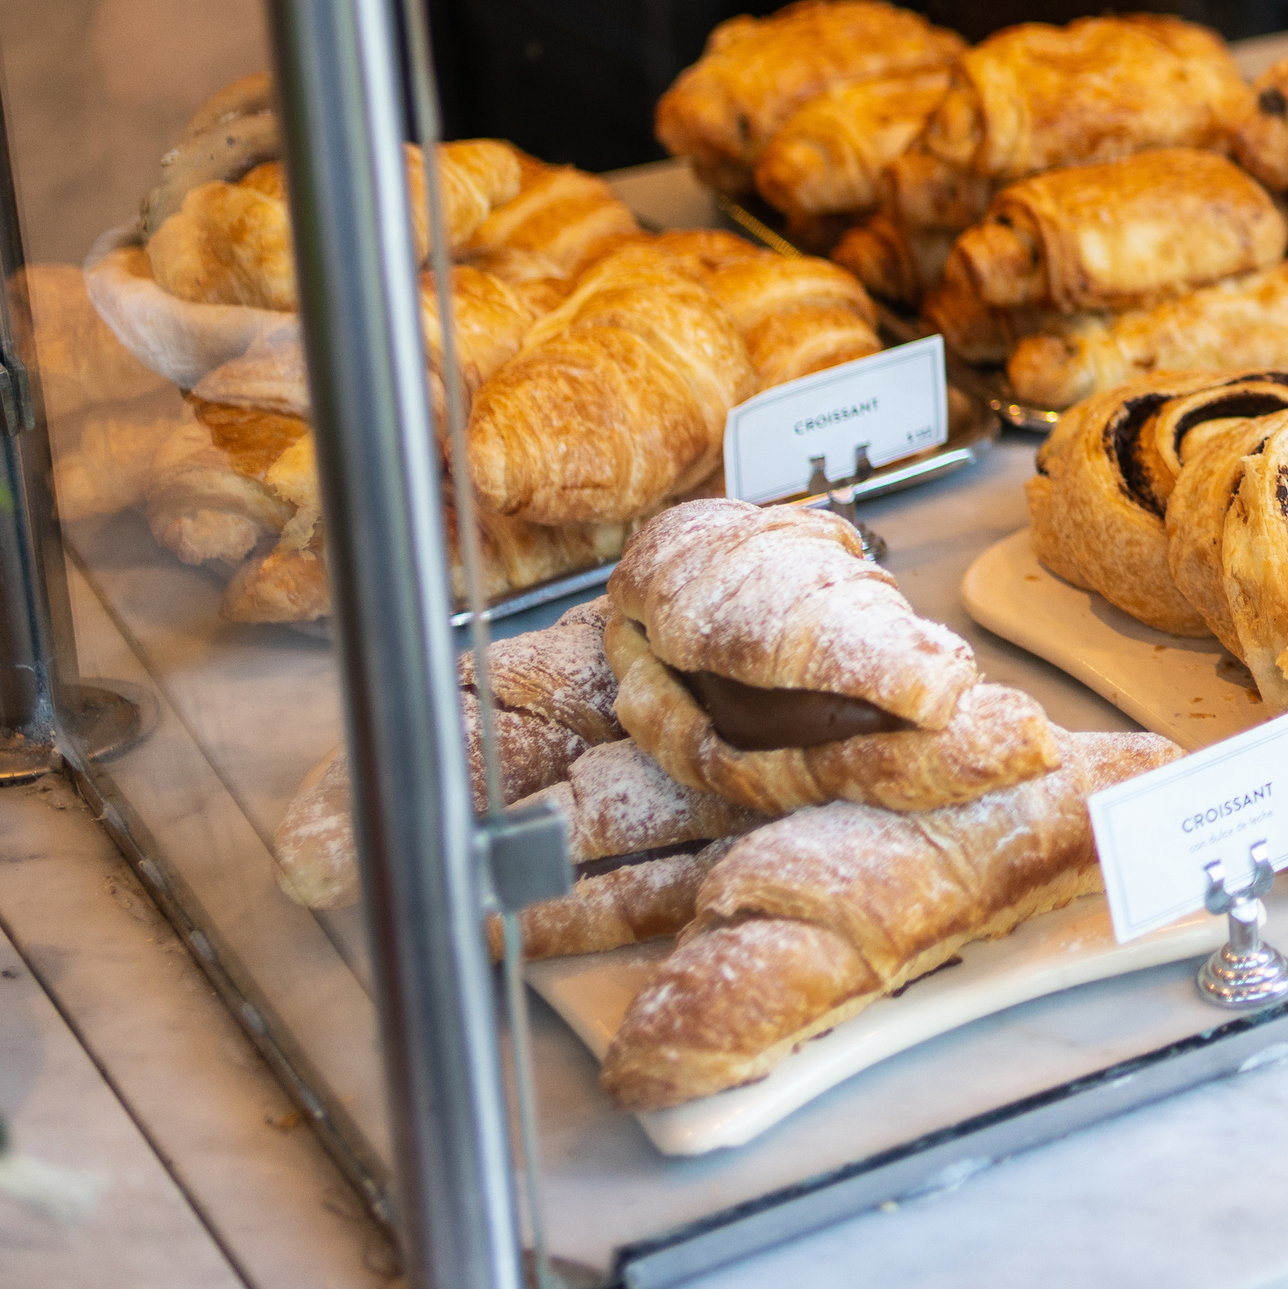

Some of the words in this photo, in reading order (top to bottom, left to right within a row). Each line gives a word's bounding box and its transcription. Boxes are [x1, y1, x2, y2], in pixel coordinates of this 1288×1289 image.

[794, 396, 879, 436] CROISSANT
[1181, 781, 1273, 833] CROISSANT
[1189, 840, 1206, 854] con
[1209, 828, 1234, 845] dulce
[1236, 820, 1247, 832] de
[1249, 810, 1273, 825] leche
